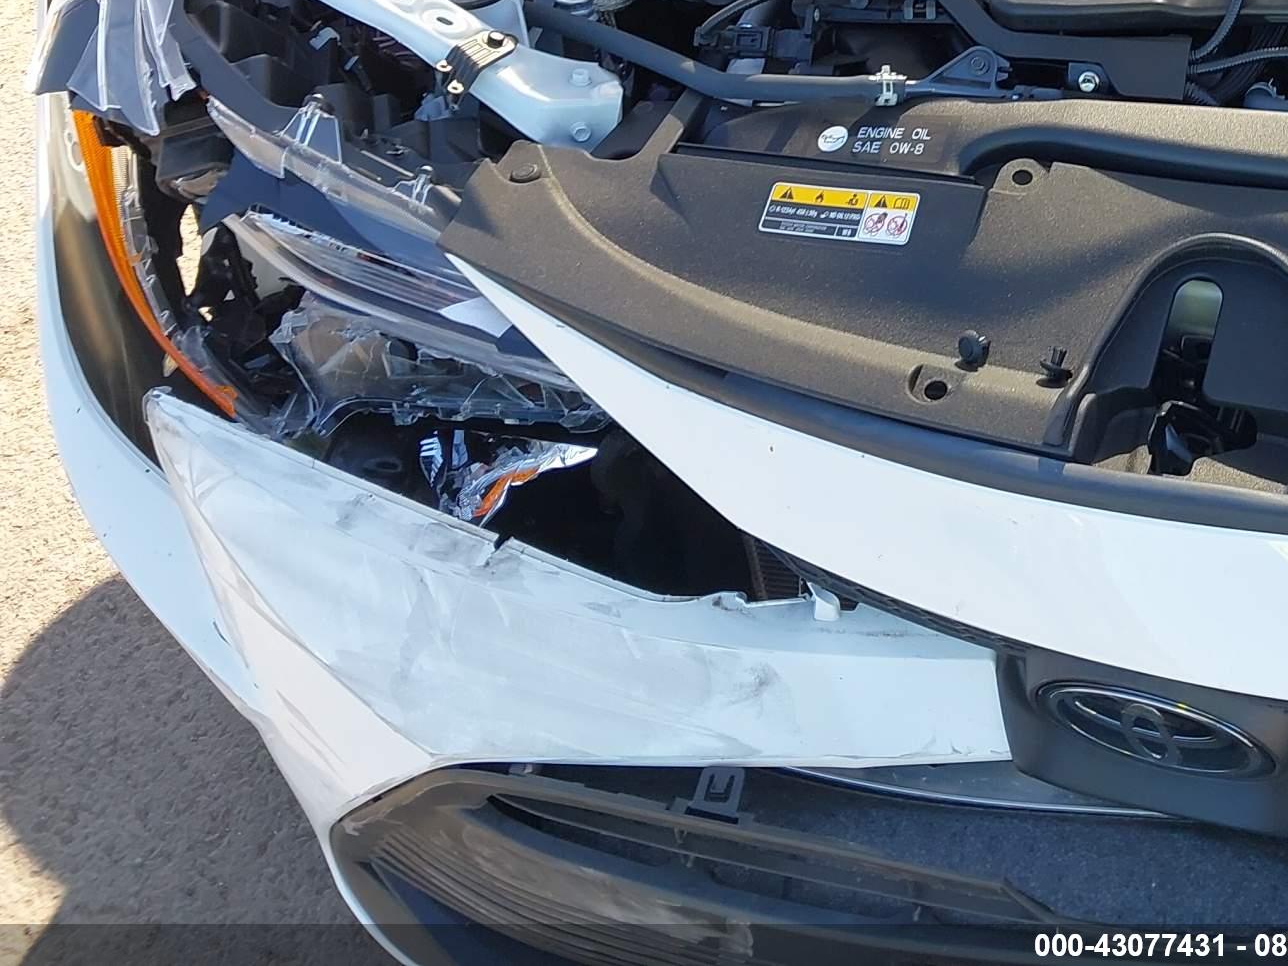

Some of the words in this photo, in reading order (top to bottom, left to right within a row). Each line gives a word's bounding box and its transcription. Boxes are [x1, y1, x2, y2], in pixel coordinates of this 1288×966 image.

[857, 127, 905, 139] ENGINE
[911, 128, 931, 140] OIL
[852, 141, 881, 153] SAE
